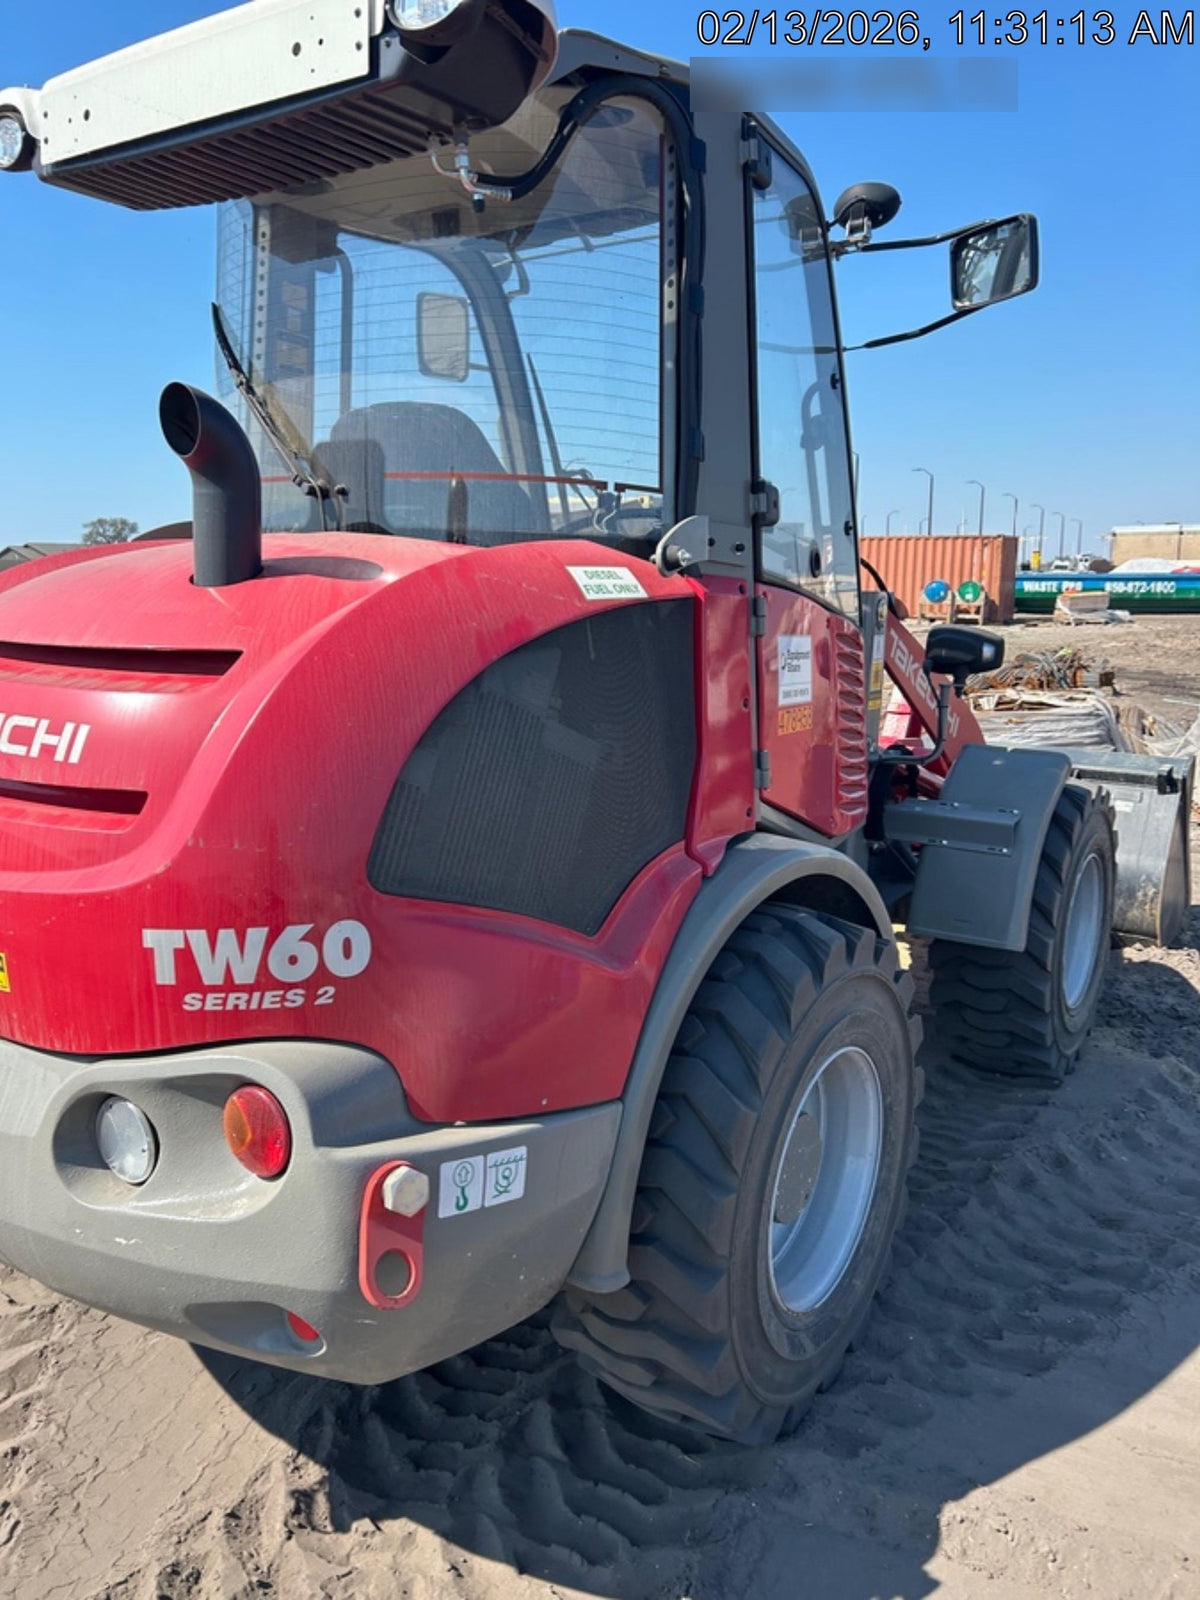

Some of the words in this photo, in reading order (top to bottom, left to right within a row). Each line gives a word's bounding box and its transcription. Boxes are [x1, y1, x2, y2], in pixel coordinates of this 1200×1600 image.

[583, 570, 623, 580] DIESEL
[583, 584, 613, 594] FUEL
[613, 584, 640, 594] ONLY
[1023, 581, 1057, 593] WASTE
[0, 712, 91, 765] CHI
[142, 919, 371, 986] TW60
[182, 988, 306, 1011] SERIES
[314, 986, 336, 1006] 2
